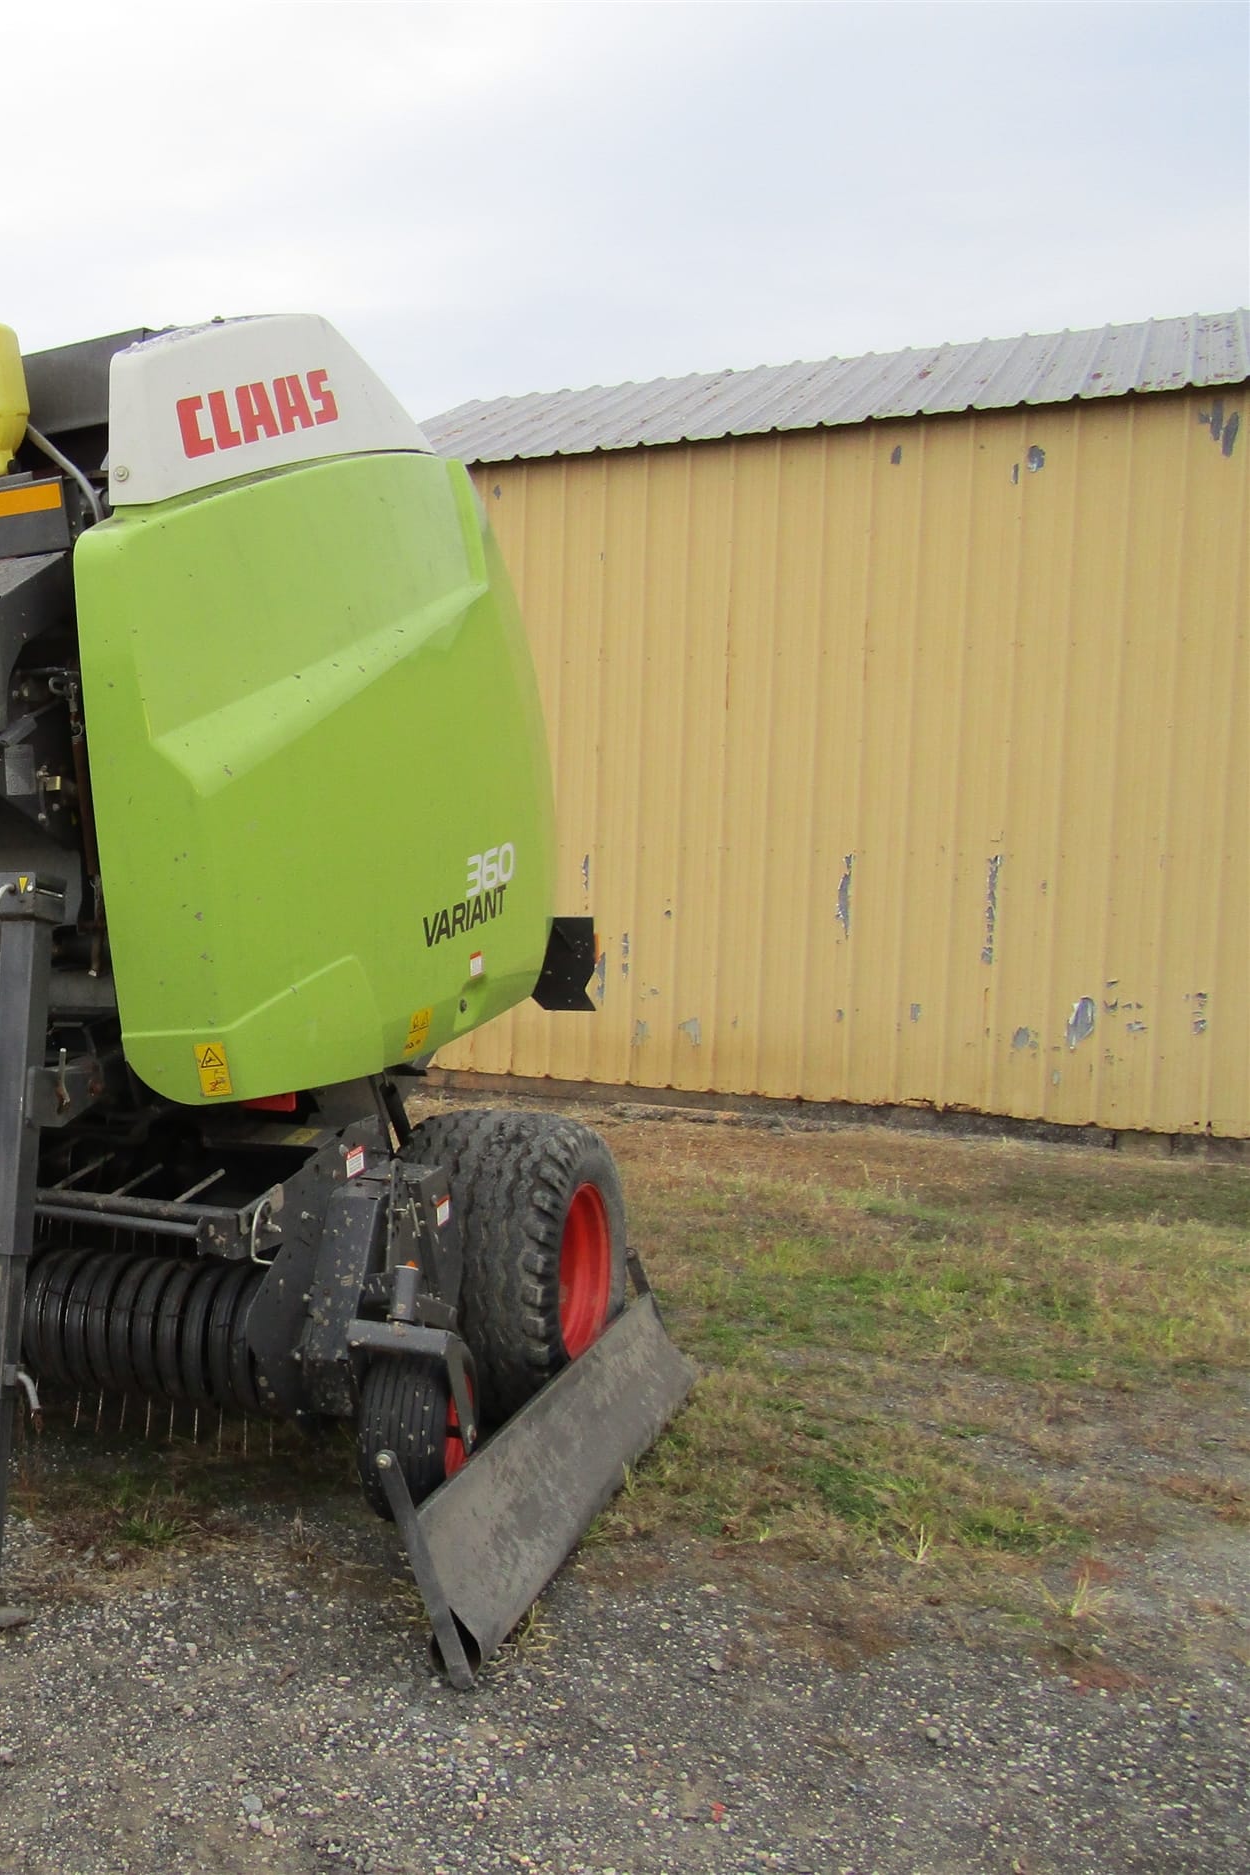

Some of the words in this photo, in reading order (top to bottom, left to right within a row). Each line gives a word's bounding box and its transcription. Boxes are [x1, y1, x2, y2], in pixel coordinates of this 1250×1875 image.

[176, 368, 339, 459] CLAAS
[466, 842, 514, 898] 360
[423, 884, 506, 947] VARIANT
